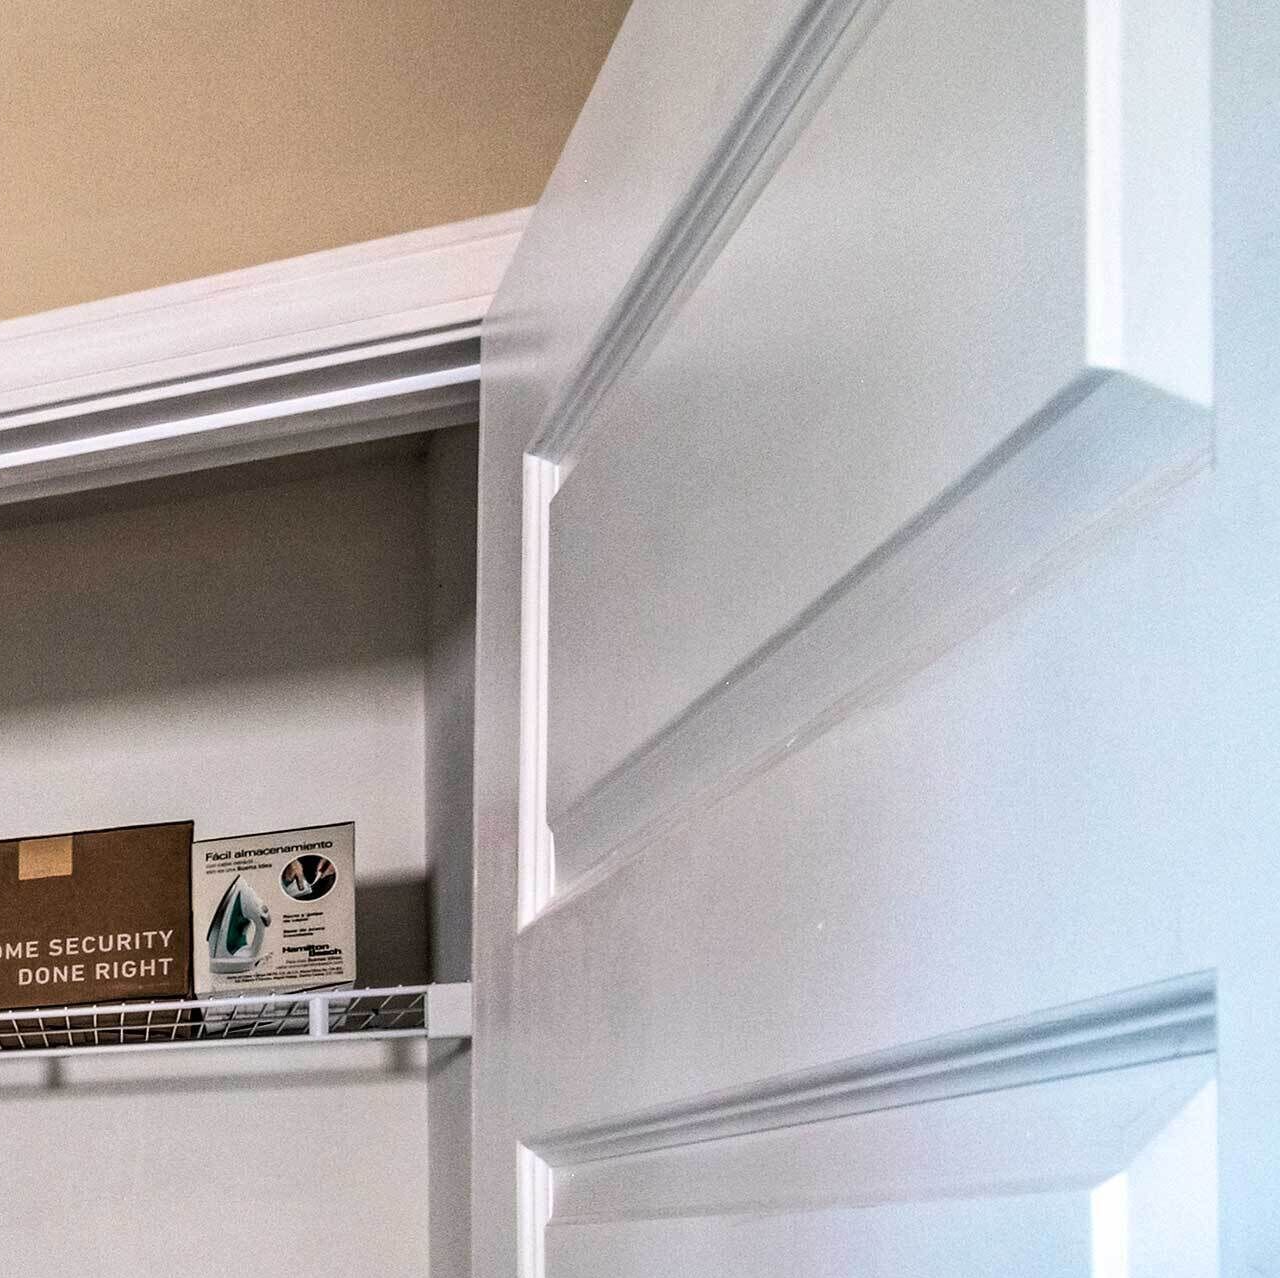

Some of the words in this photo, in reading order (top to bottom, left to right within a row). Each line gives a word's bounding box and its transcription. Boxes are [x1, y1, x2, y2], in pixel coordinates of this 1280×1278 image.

[204, 851, 232, 862] Fácil
[234, 840, 333, 860] almacenamiento
[48, 929, 174, 957] SECURITY
[281, 943, 330, 954] Hamilton
[17, 964, 86, 986] DONE
[95, 957, 174, 980] RIGHT
